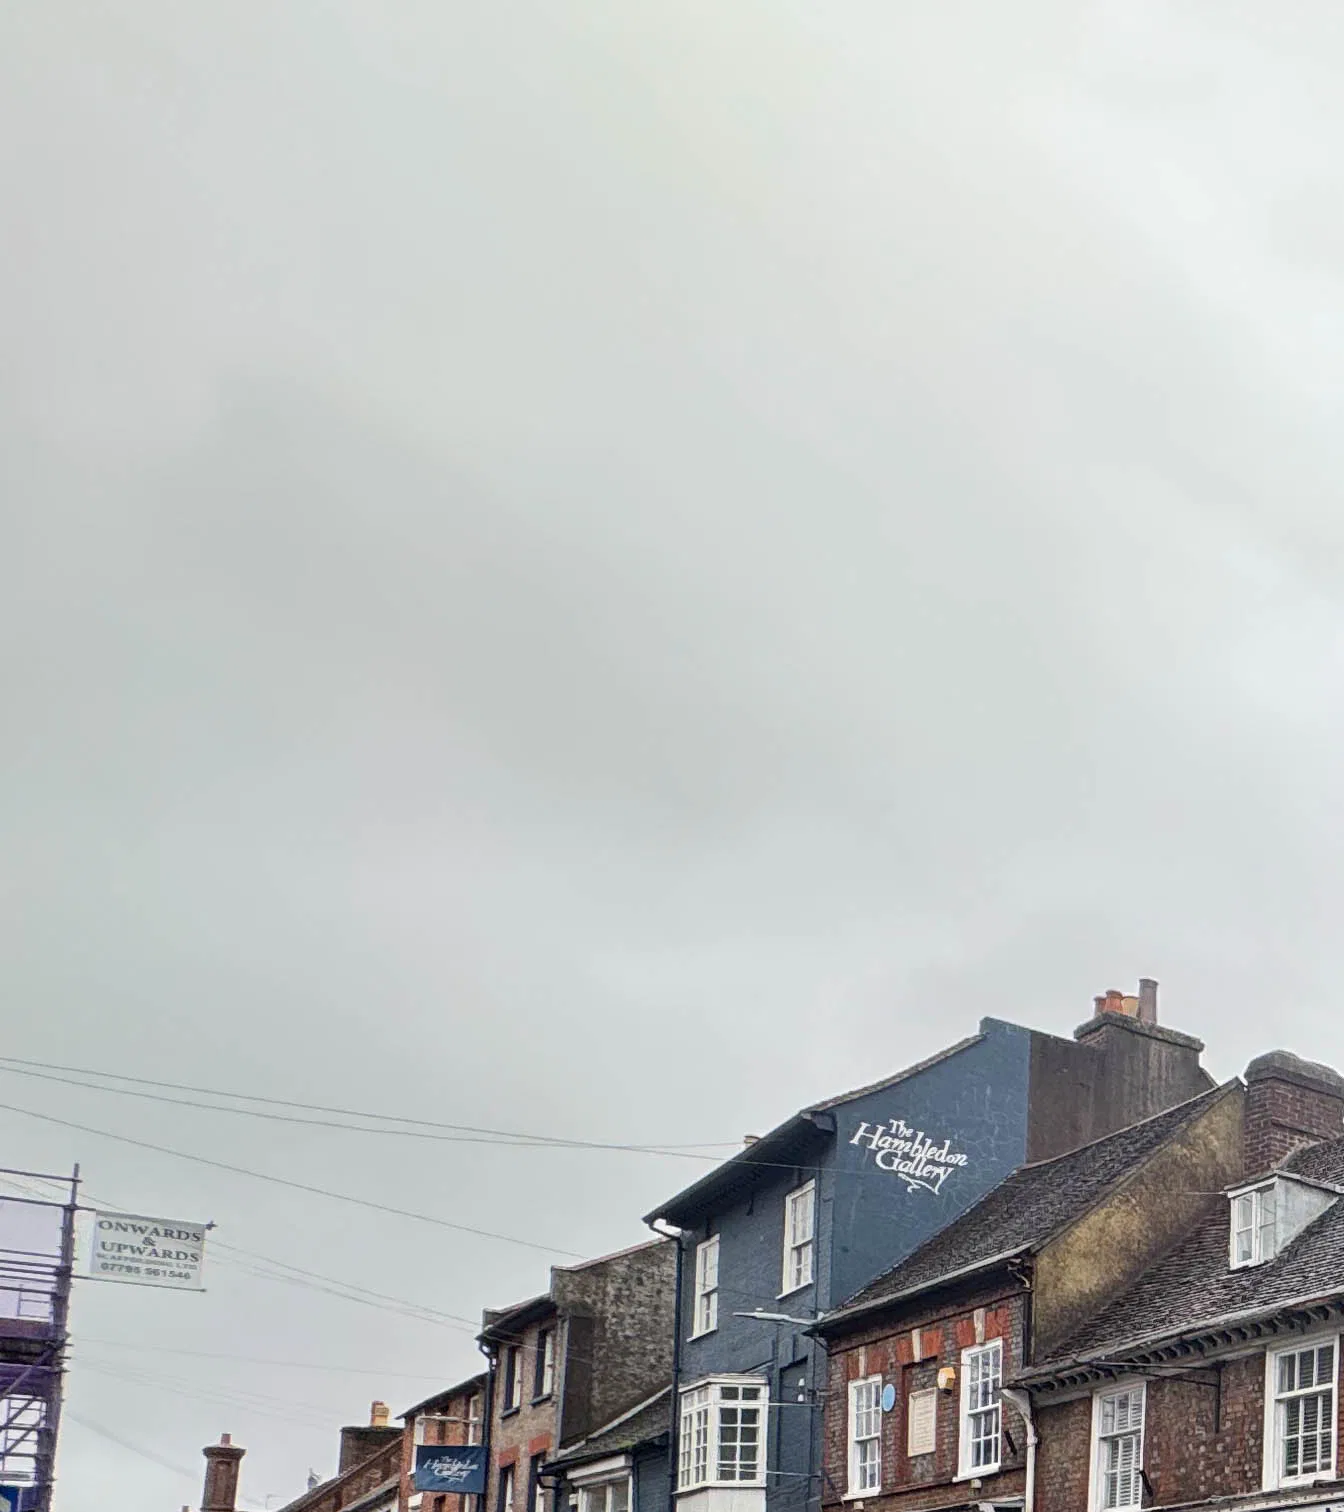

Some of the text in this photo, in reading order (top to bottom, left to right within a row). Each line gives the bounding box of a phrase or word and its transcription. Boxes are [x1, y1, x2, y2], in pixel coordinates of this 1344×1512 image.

[888, 1119, 913, 1137] The
[849, 1122, 968, 1166] Hambledon
[876, 1149, 954, 1195] Gallery
[98, 1220, 201, 1242] ONWARDS
[142, 1236, 156, 1247] &
[101, 1241, 200, 1262] UPWARDS
